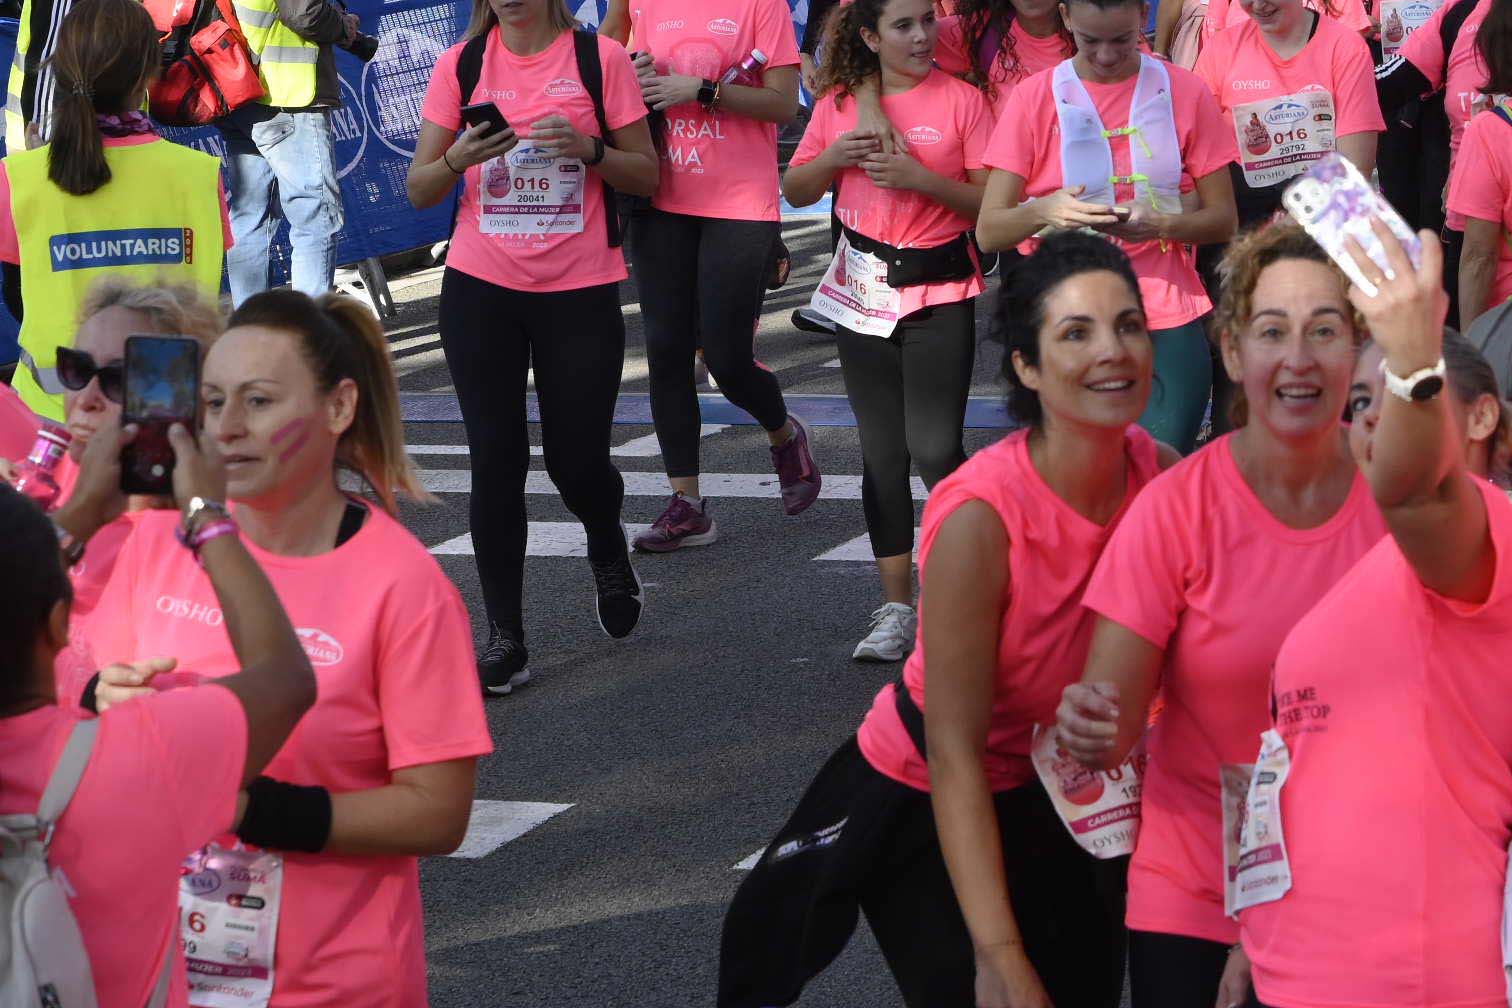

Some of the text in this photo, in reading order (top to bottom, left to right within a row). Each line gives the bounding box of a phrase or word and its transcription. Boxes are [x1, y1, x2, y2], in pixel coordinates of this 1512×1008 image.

[1232, 79, 1271, 90] OYSHO
[1273, 128, 1308, 145] 016
[1279, 143, 1306, 156] 29792
[514, 177, 550, 191] 016
[517, 194, 545, 203] 20041
[489, 217, 520, 227] OYSHO
[52, 238, 181, 265] VOLUNTARIS
